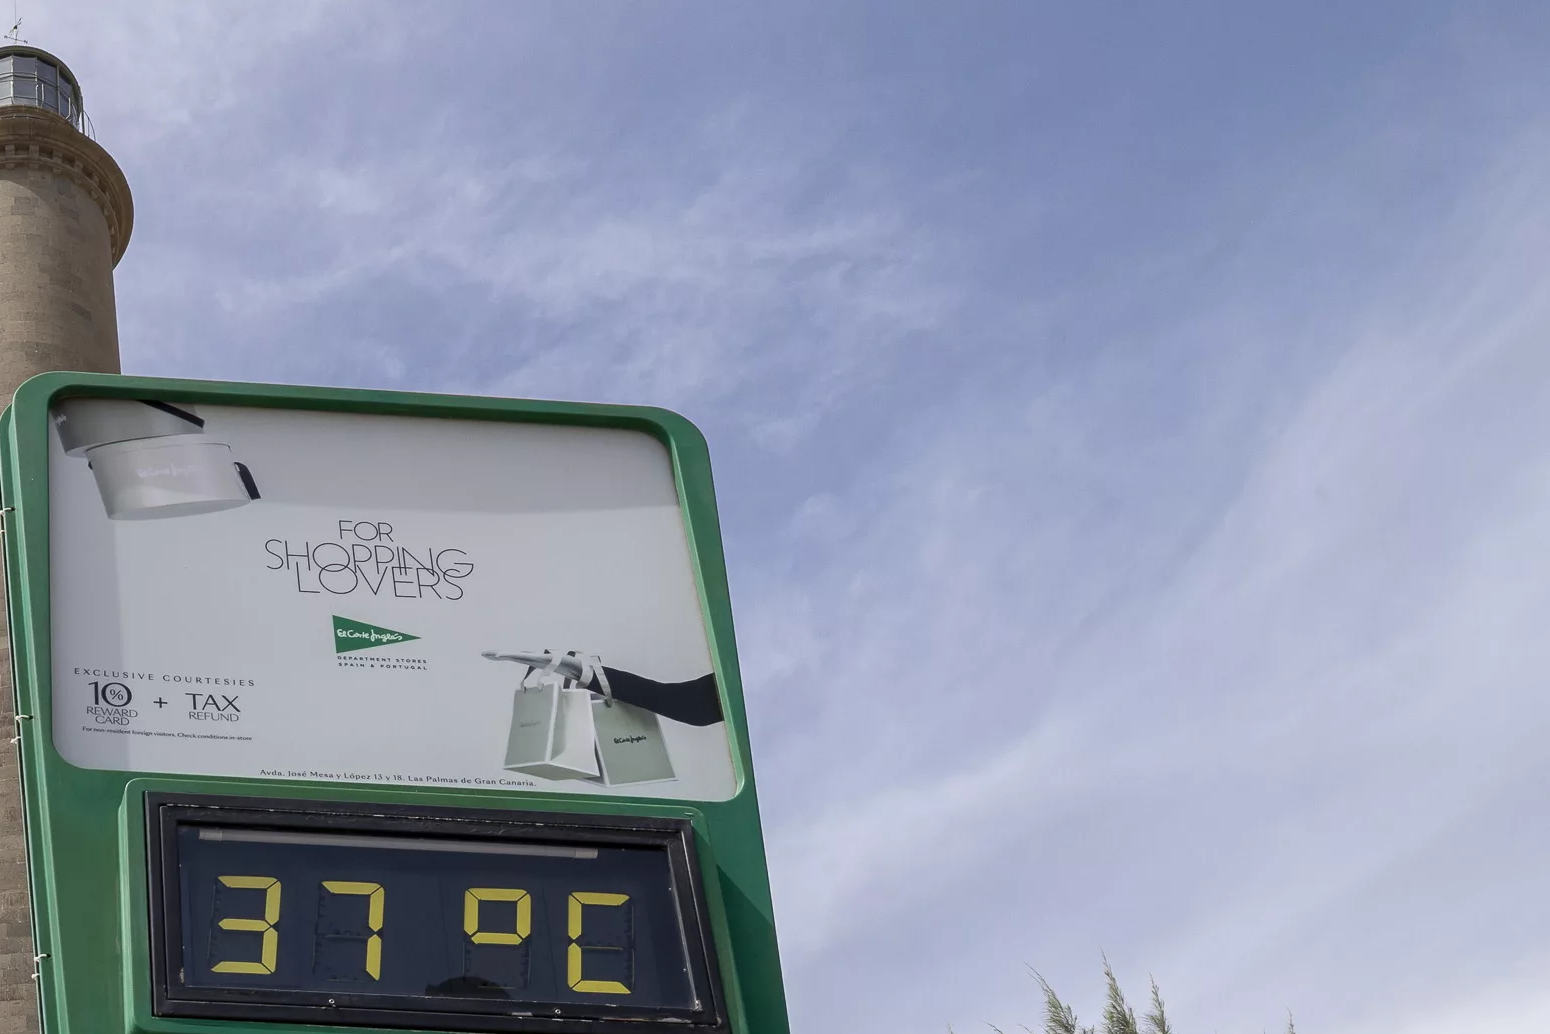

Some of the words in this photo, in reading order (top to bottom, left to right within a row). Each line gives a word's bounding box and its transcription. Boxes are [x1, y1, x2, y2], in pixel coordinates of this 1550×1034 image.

[339, 520, 393, 542] FOR
[265, 539, 474, 578] SHOPPING
[296, 561, 463, 600] LOVERS
[74, 667, 154, 681] EXCLUSIVE
[162, 674, 255, 687] COURTESIES
[86, 706, 138, 718] REWARD
[185, 692, 241, 712] TAX
[95, 715, 130, 725] CARD
[188, 711, 239, 722] REFUND
[260, 769, 285, 777] Avda.
[344, 772, 371, 780] López
[499, 779, 537, 787] Canaria.
[211, 876, 384, 981] 37
